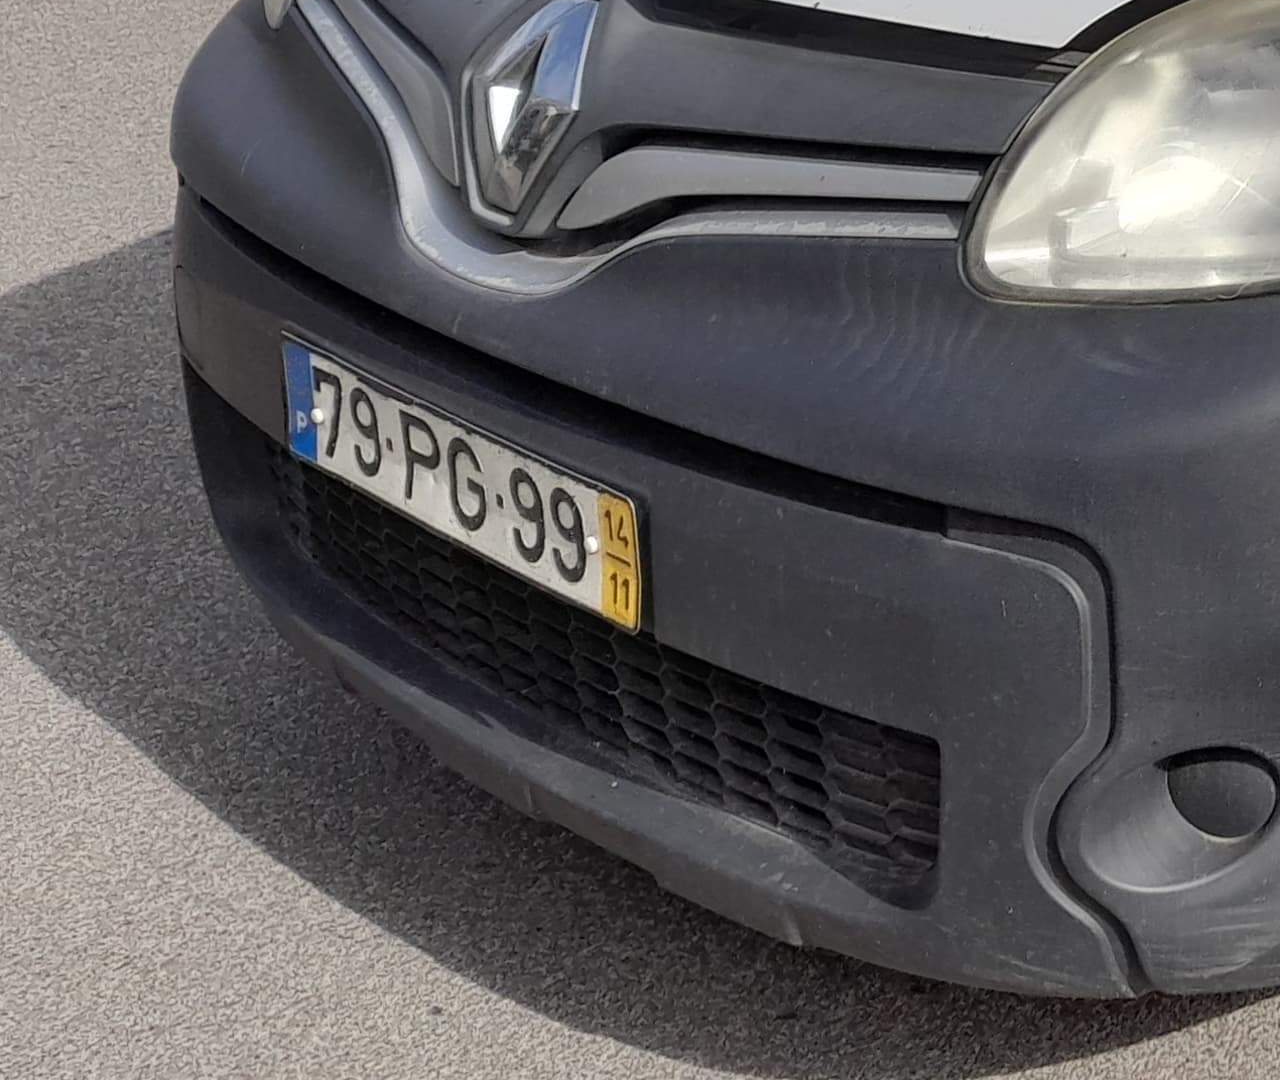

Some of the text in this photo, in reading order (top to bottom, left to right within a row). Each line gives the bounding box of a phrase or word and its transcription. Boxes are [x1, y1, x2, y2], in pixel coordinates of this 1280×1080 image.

[295, 409, 308, 434] P
[604, 508, 630, 550] 14
[610, 571, 631, 611] 11
